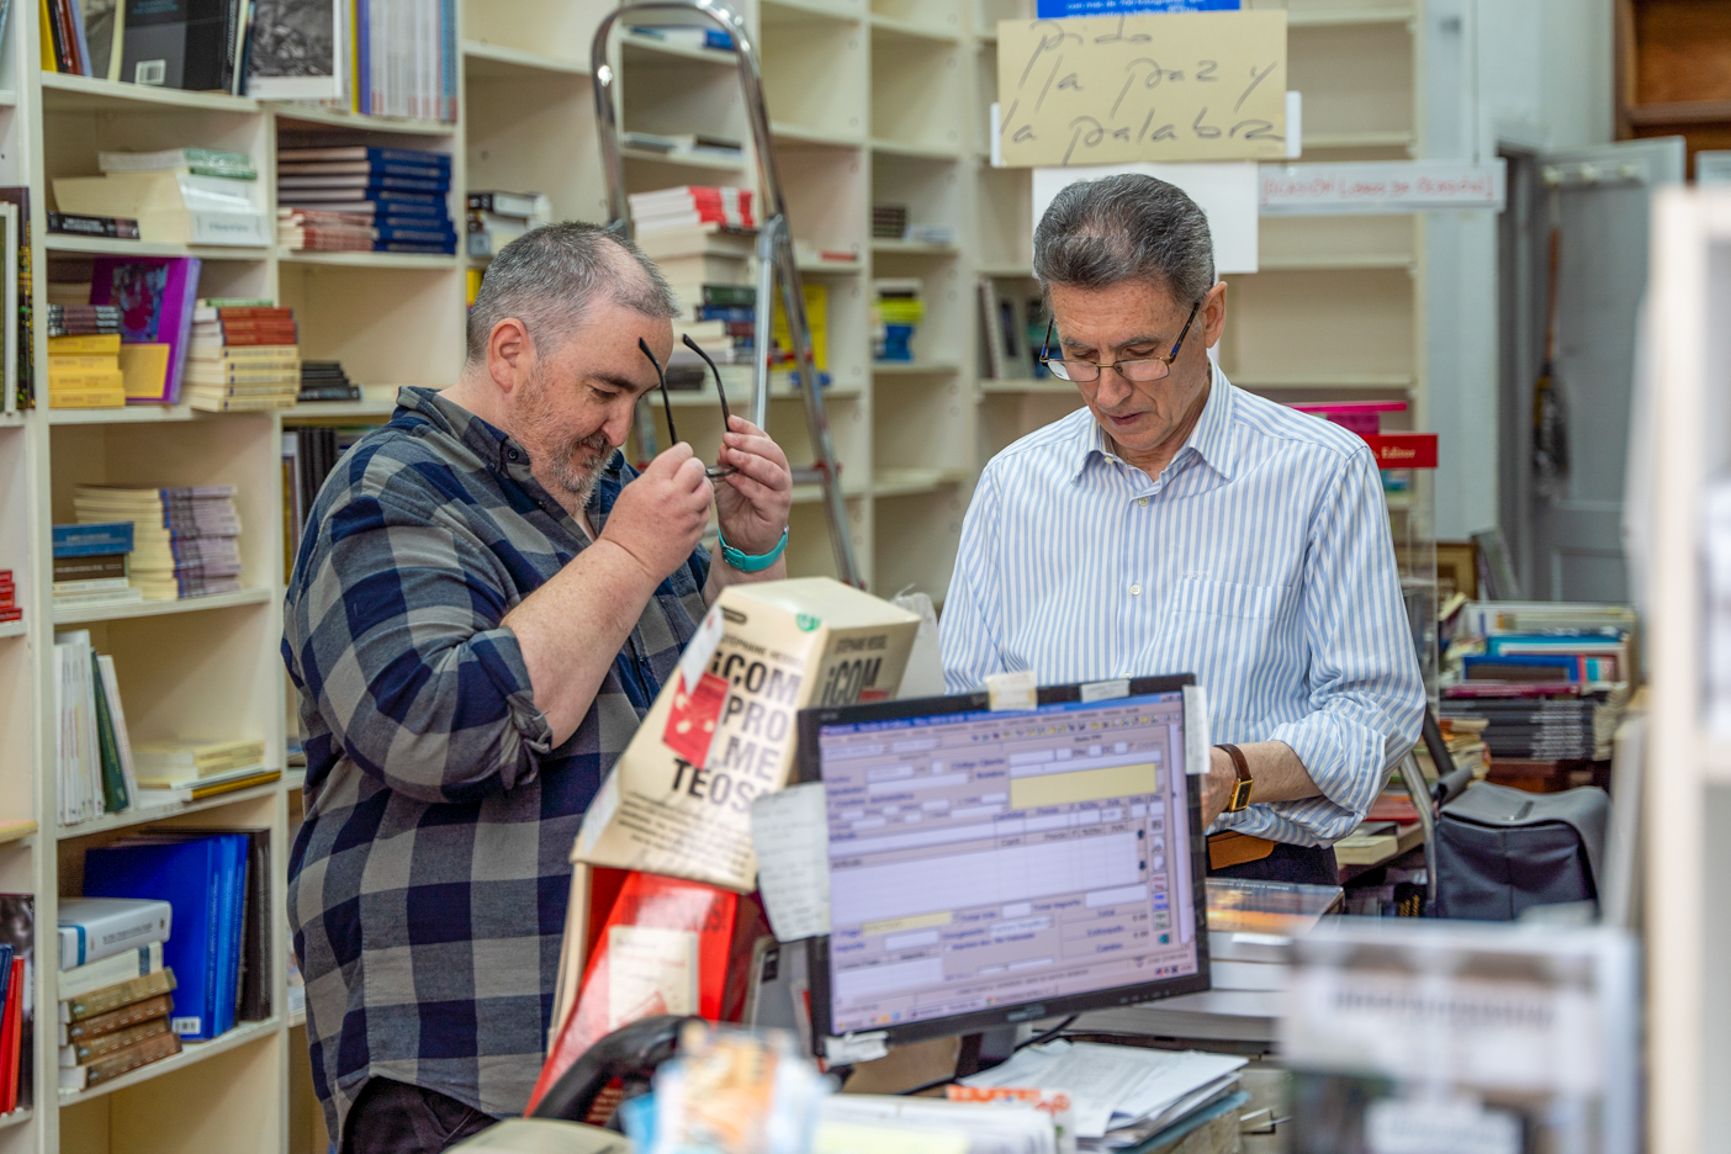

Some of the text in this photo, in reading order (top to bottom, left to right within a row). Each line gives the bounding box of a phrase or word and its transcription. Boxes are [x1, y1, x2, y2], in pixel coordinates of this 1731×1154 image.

[1110, 57, 1218, 119] paz
[1000, 98, 1287, 166] la palabra
[722, 695, 789, 743] PRO
[672, 757, 768, 813] TEOS
[723, 735, 780, 782] ME
